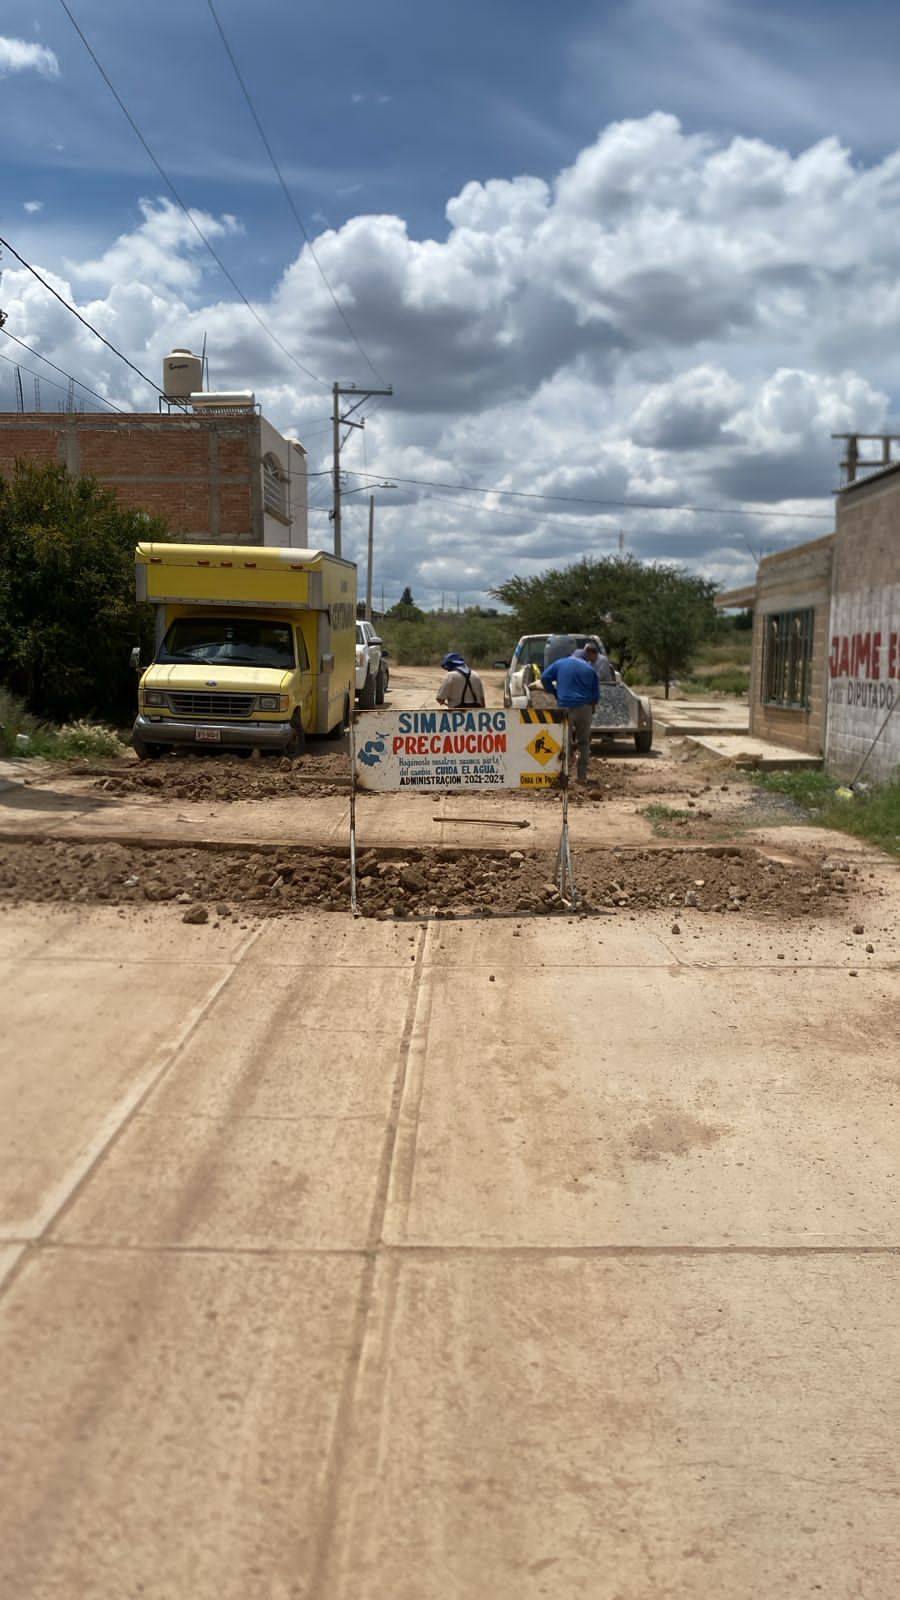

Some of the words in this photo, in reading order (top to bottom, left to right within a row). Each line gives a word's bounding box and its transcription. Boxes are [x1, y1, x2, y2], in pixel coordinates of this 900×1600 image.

[829, 631, 881, 680] JAIME
[887, 631, 900, 680] E
[847, 680, 894, 709] DIPUTADO
[398, 712, 506, 733] SIMAPARG
[392, 728, 507, 755] PRECAUCIÓN
[435, 766, 458, 775] CUIDA
[462, 766, 471, 774] EL
